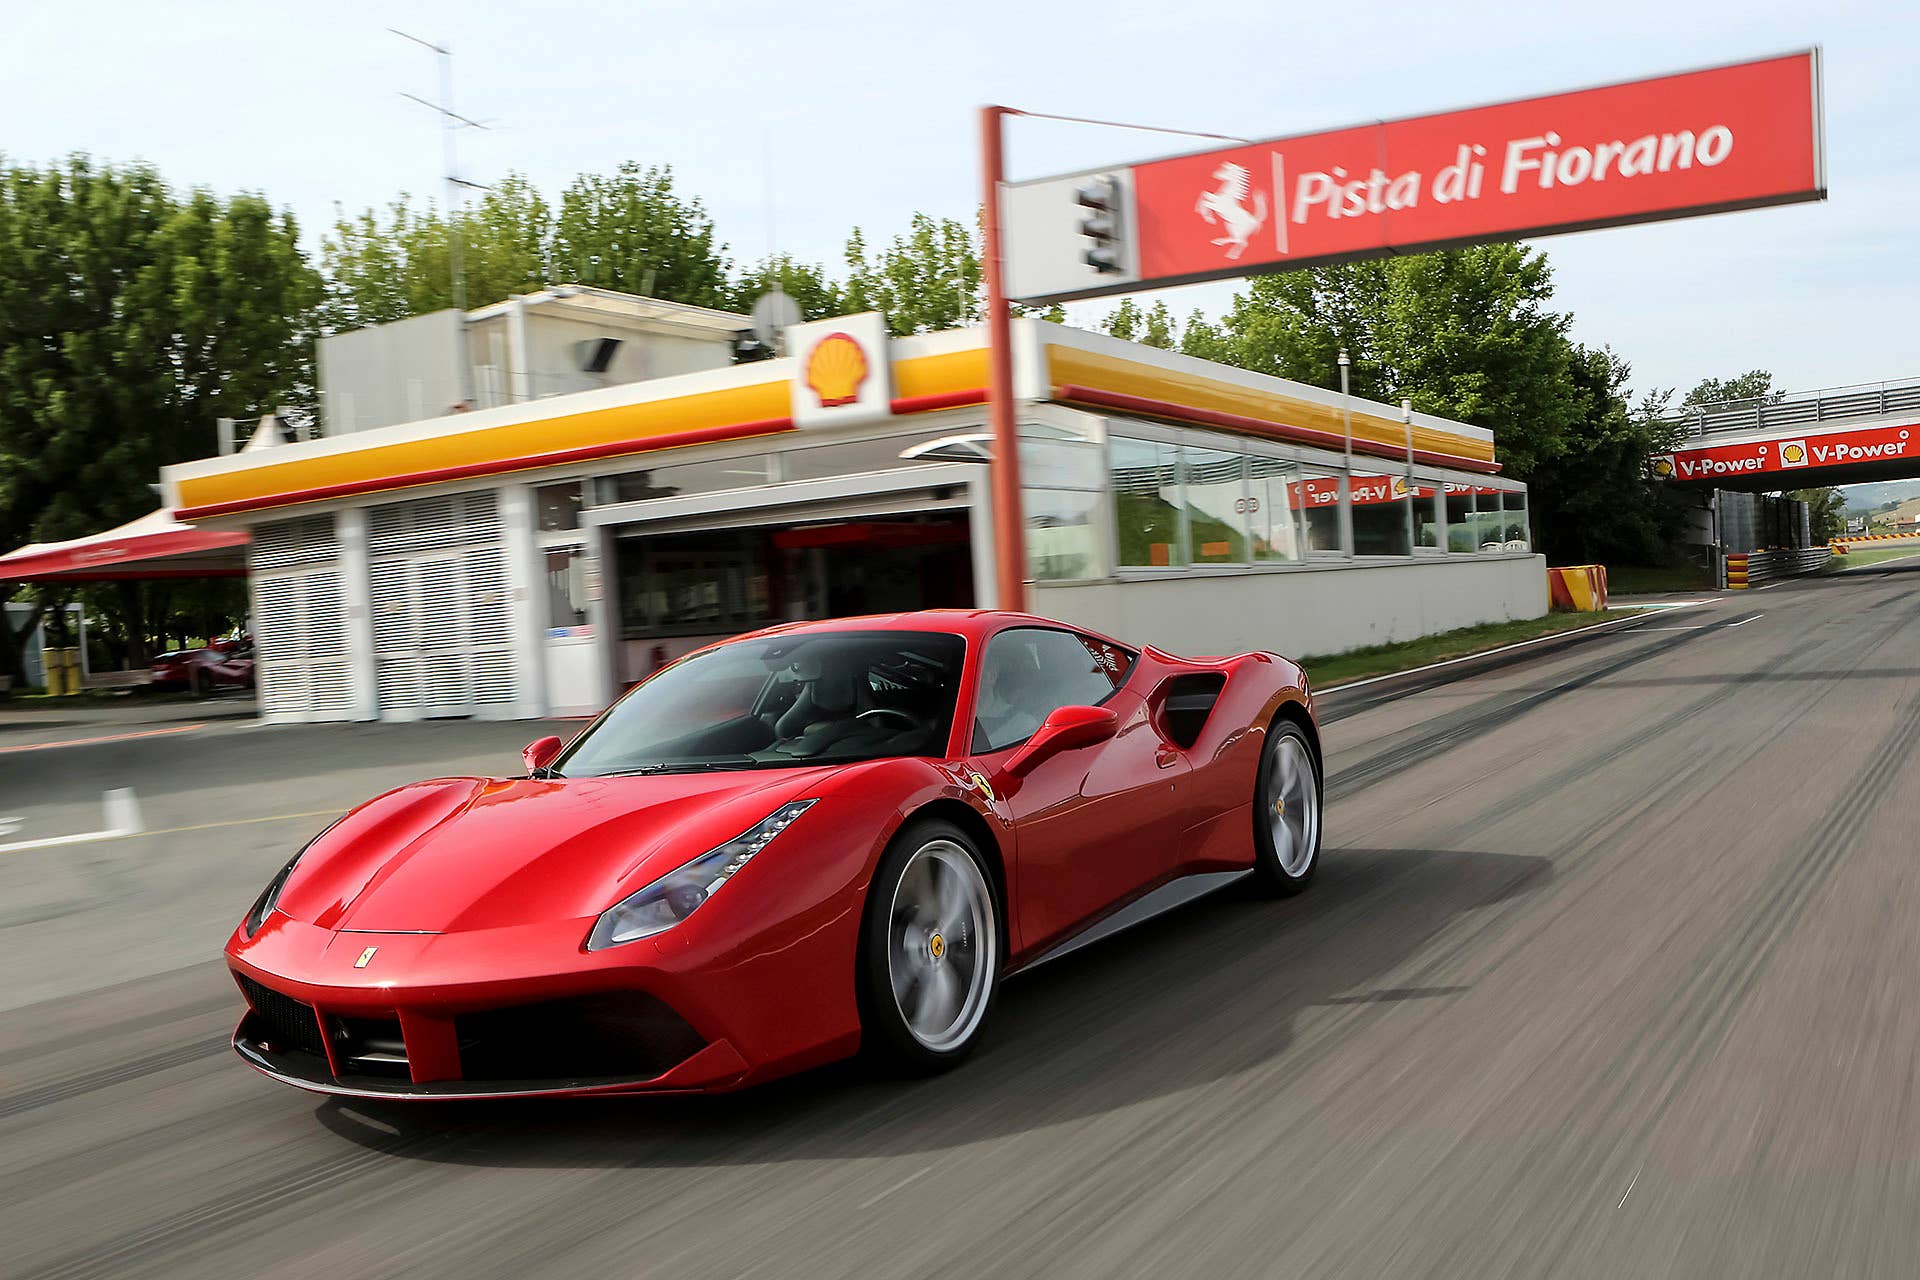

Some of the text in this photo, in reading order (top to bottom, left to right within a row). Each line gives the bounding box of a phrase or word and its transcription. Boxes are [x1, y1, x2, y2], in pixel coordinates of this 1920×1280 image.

[1292, 125, 1733, 224] Pista di Fiorano
[1812, 441, 1906, 463] V-Power
[1680, 455, 1765, 476] V-Power
